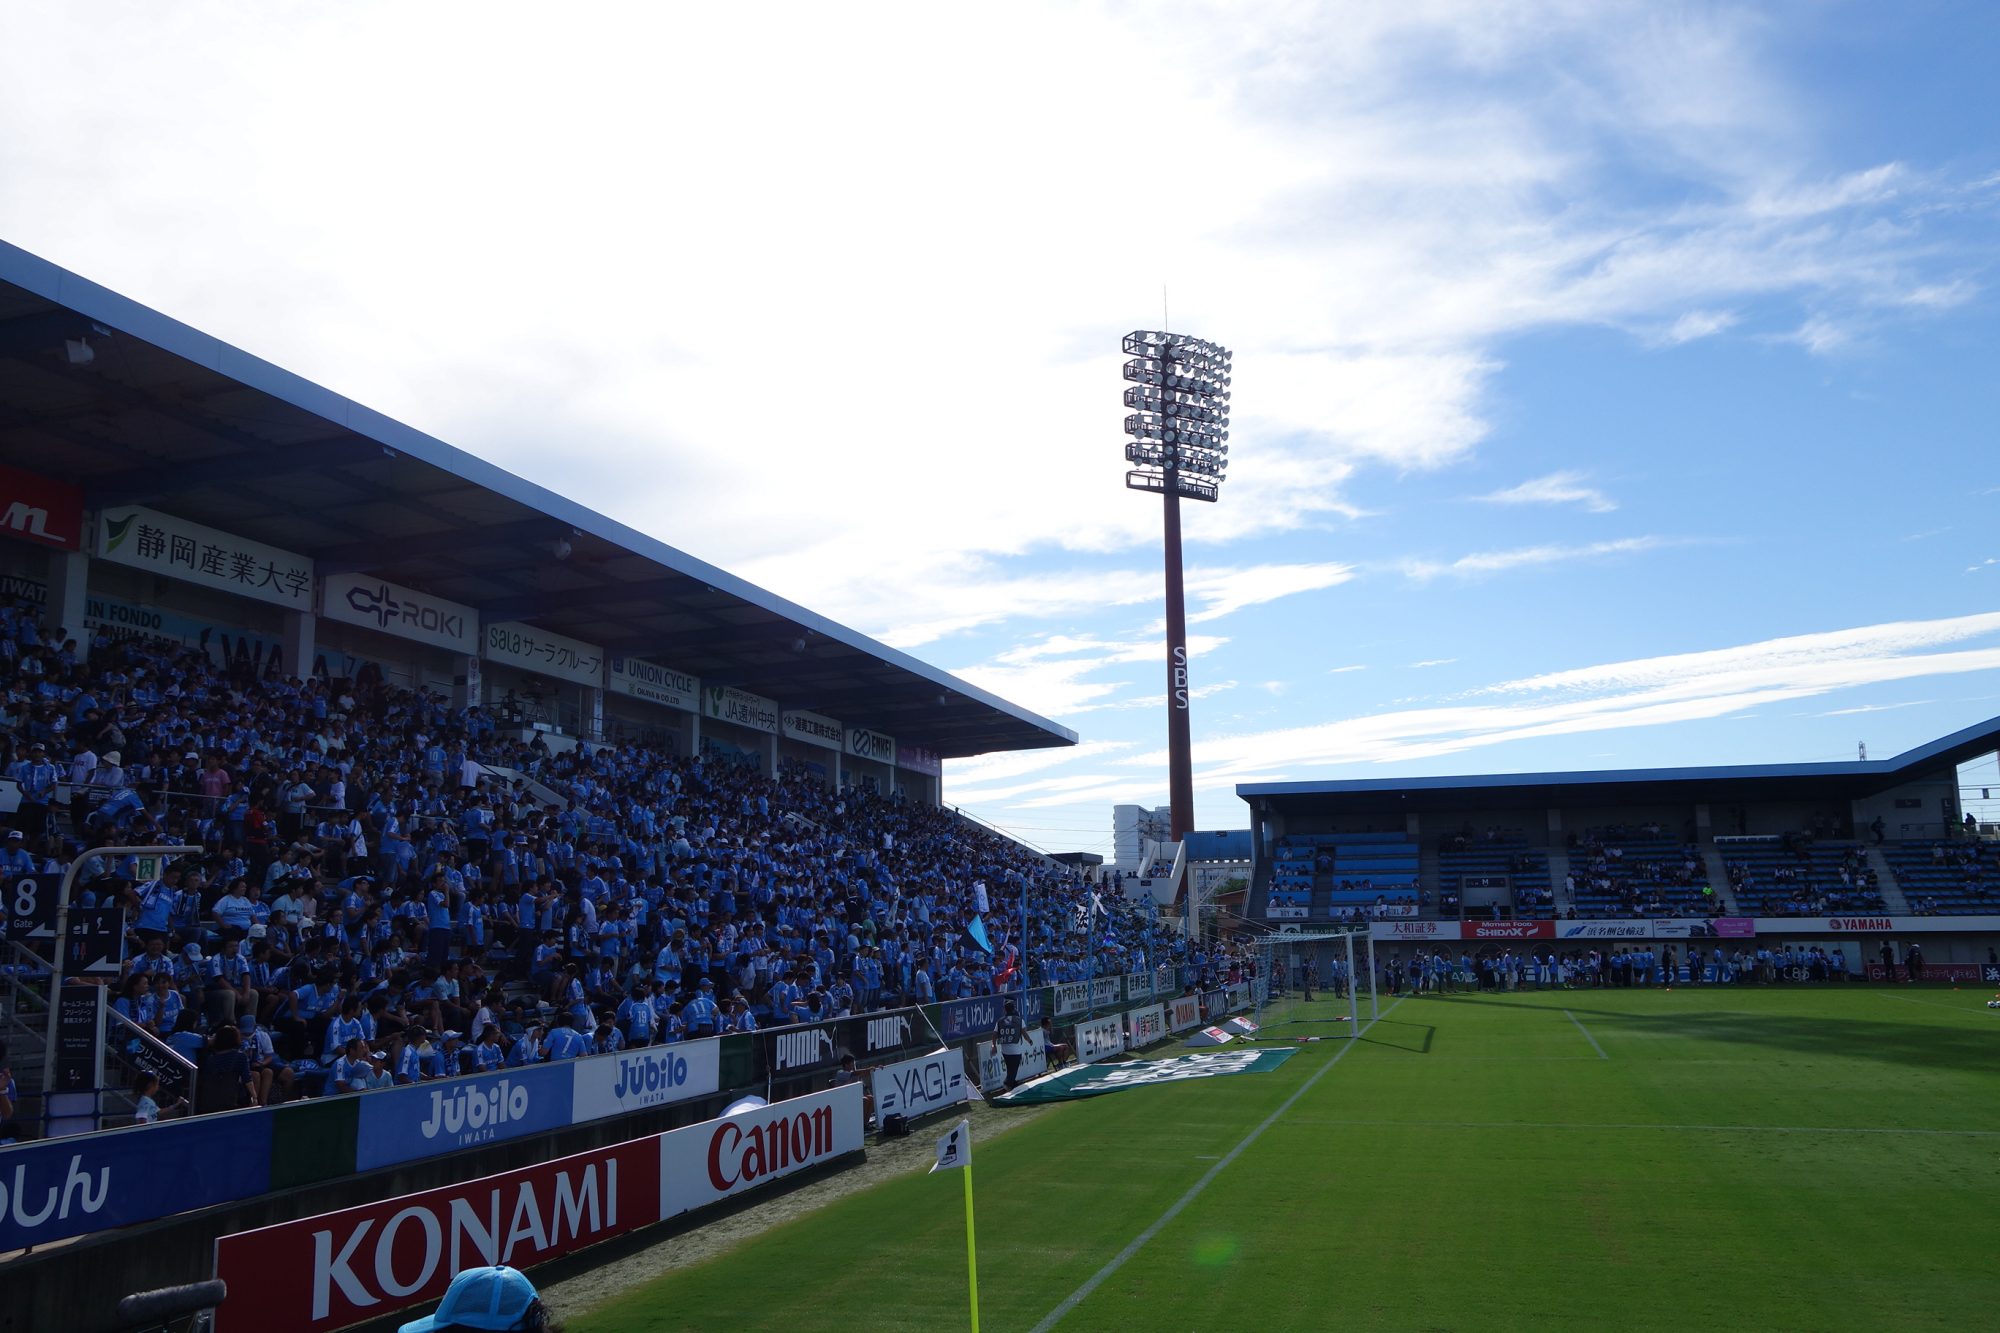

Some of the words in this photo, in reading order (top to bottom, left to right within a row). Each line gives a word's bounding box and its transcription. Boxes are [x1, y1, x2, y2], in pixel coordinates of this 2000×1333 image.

[137, 524, 309, 597] 静岡産業大学
[110, 604, 161, 630] FONDO
[402, 604, 463, 639] ROKI
[523, 633, 601, 674] サーラグループ
[629, 660, 662, 684] UNION
[665, 671, 692, 692] CYCLE
[1173, 646, 1188, 709] SBS
[725, 700, 776, 731] JA遠州中央
[14, 879, 38, 916] 8
[13, 919, 33, 929] Gate
[1392, 922, 1437, 934] 大和証券
[1843, 919, 1892, 930] YAMAHA
[966, 1001, 994, 1028] いわしん
[776, 1029, 822, 1071] PUMA
[867, 1015, 901, 1051] PUMA
[615, 1051, 687, 1100] Júbilo
[893, 1060, 948, 1110] YAGI
[421, 1080, 529, 1139] Júbilo
[639, 1092, 665, 1105] IWATA
[458, 1128, 496, 1146] IWATA
[708, 1104, 833, 1191] Canon
[312, 1157, 618, 1321] KONAMI
